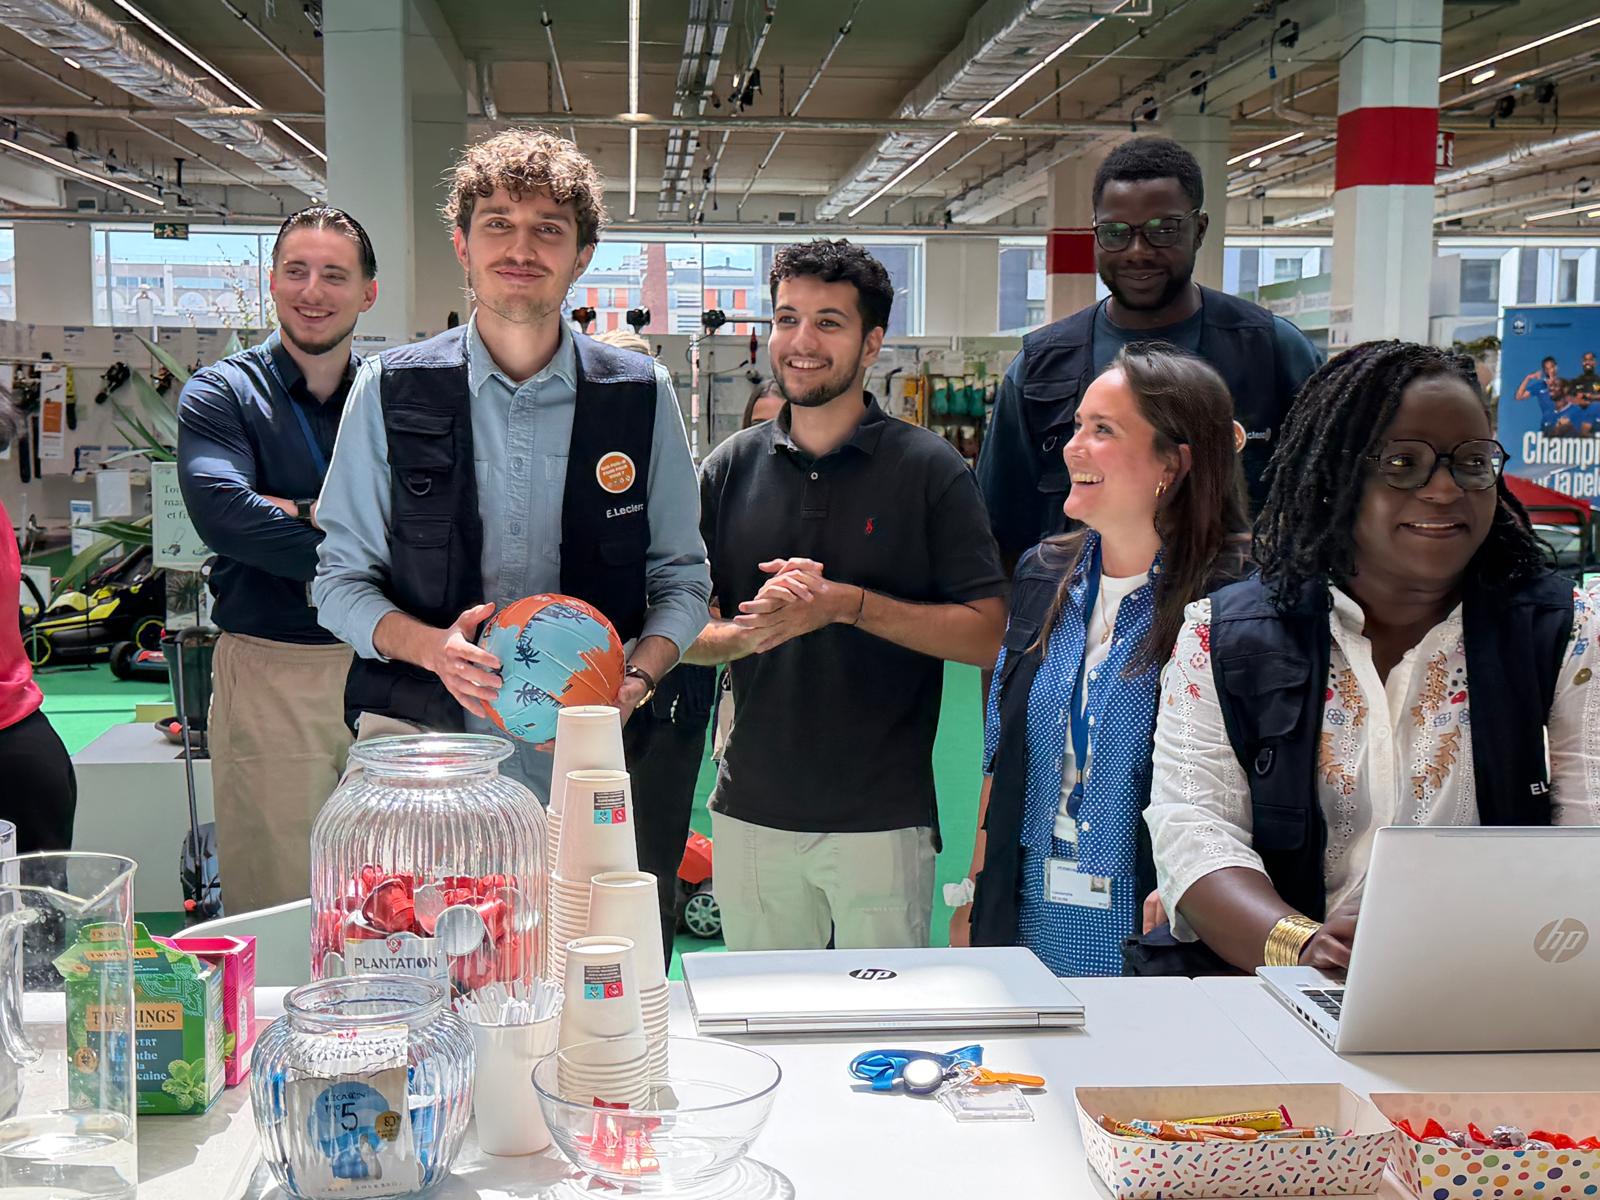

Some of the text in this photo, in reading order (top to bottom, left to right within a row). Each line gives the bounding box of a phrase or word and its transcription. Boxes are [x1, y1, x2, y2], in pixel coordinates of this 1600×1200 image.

[1522, 431, 1600, 470] Champi
[1536, 917, 1588, 963] hp
[354, 957, 438, 969] PLANTATION
[850, 968, 897, 981] hp
[92, 1009, 176, 1025] TWIINGS
